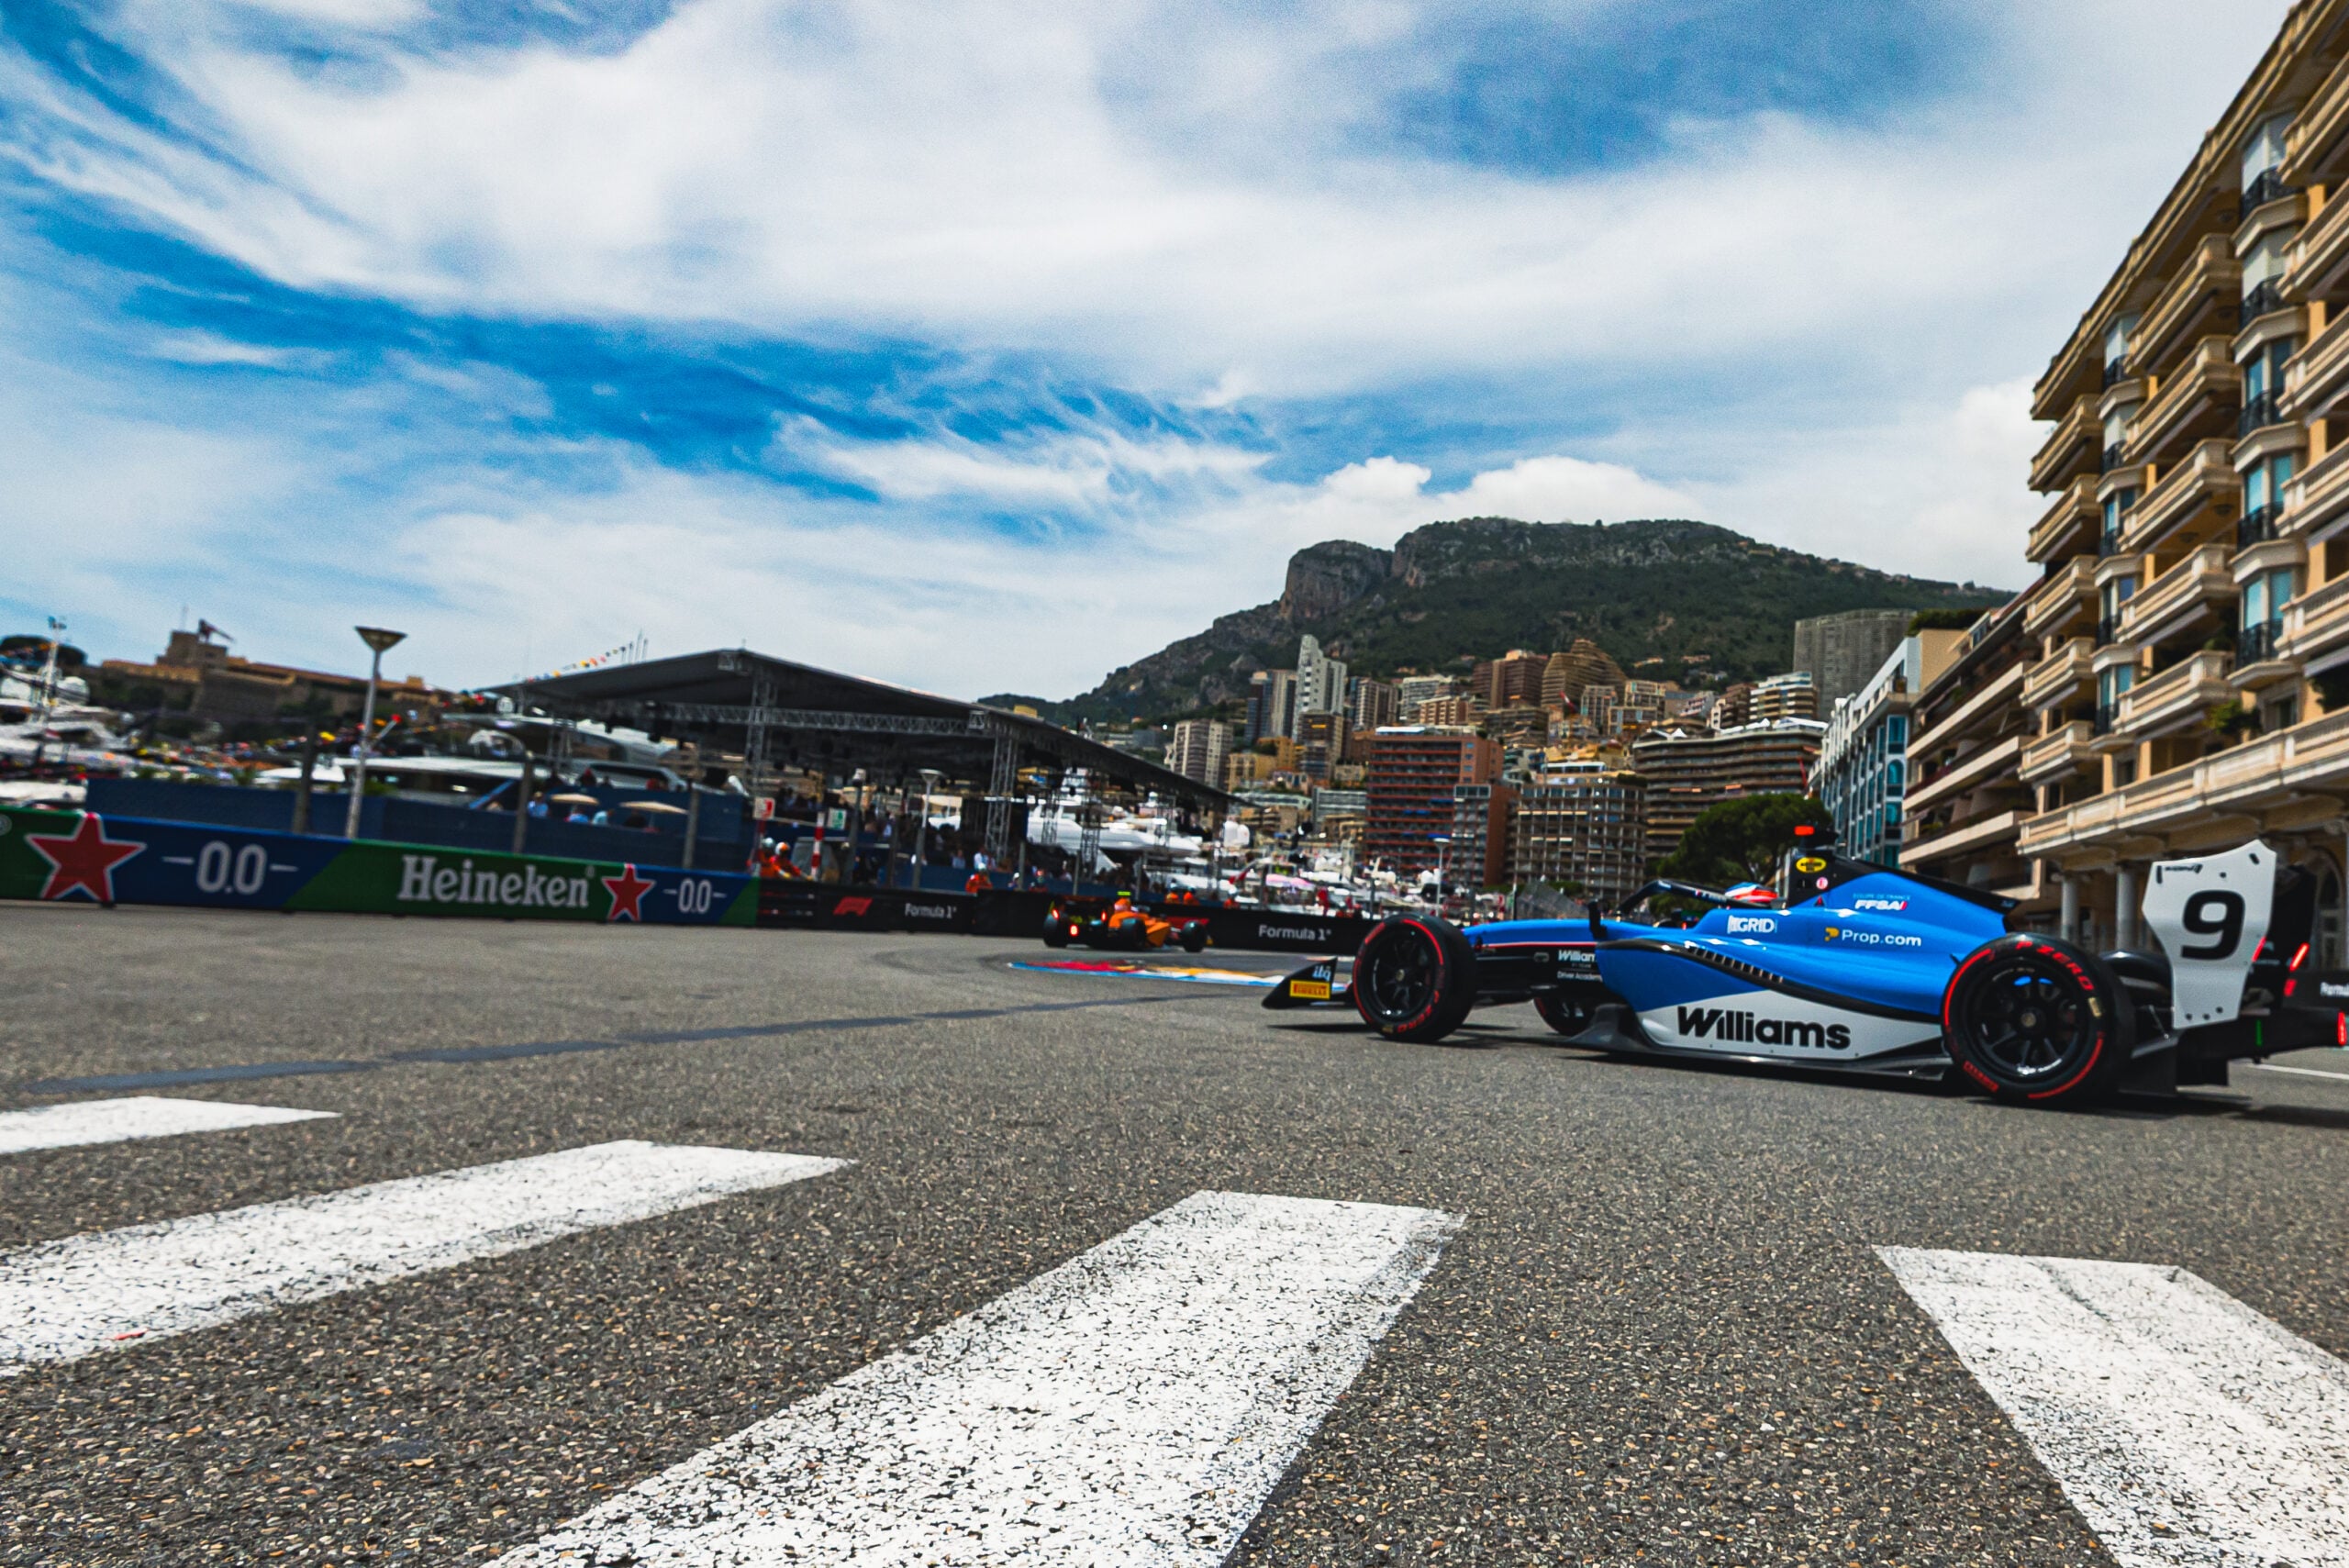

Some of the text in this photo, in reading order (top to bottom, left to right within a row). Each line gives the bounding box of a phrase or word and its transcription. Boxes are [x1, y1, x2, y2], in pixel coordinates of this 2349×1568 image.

[397, 854, 590, 908] Heineken
[905, 903, 945, 918] Formula
[1258, 925, 1316, 940] Formula
[2181, 890, 2246, 961] 9
[1842, 929, 1922, 947] Prop.com
[1558, 950, 1597, 962] William
[1677, 1006, 1851, 1051] Williams
